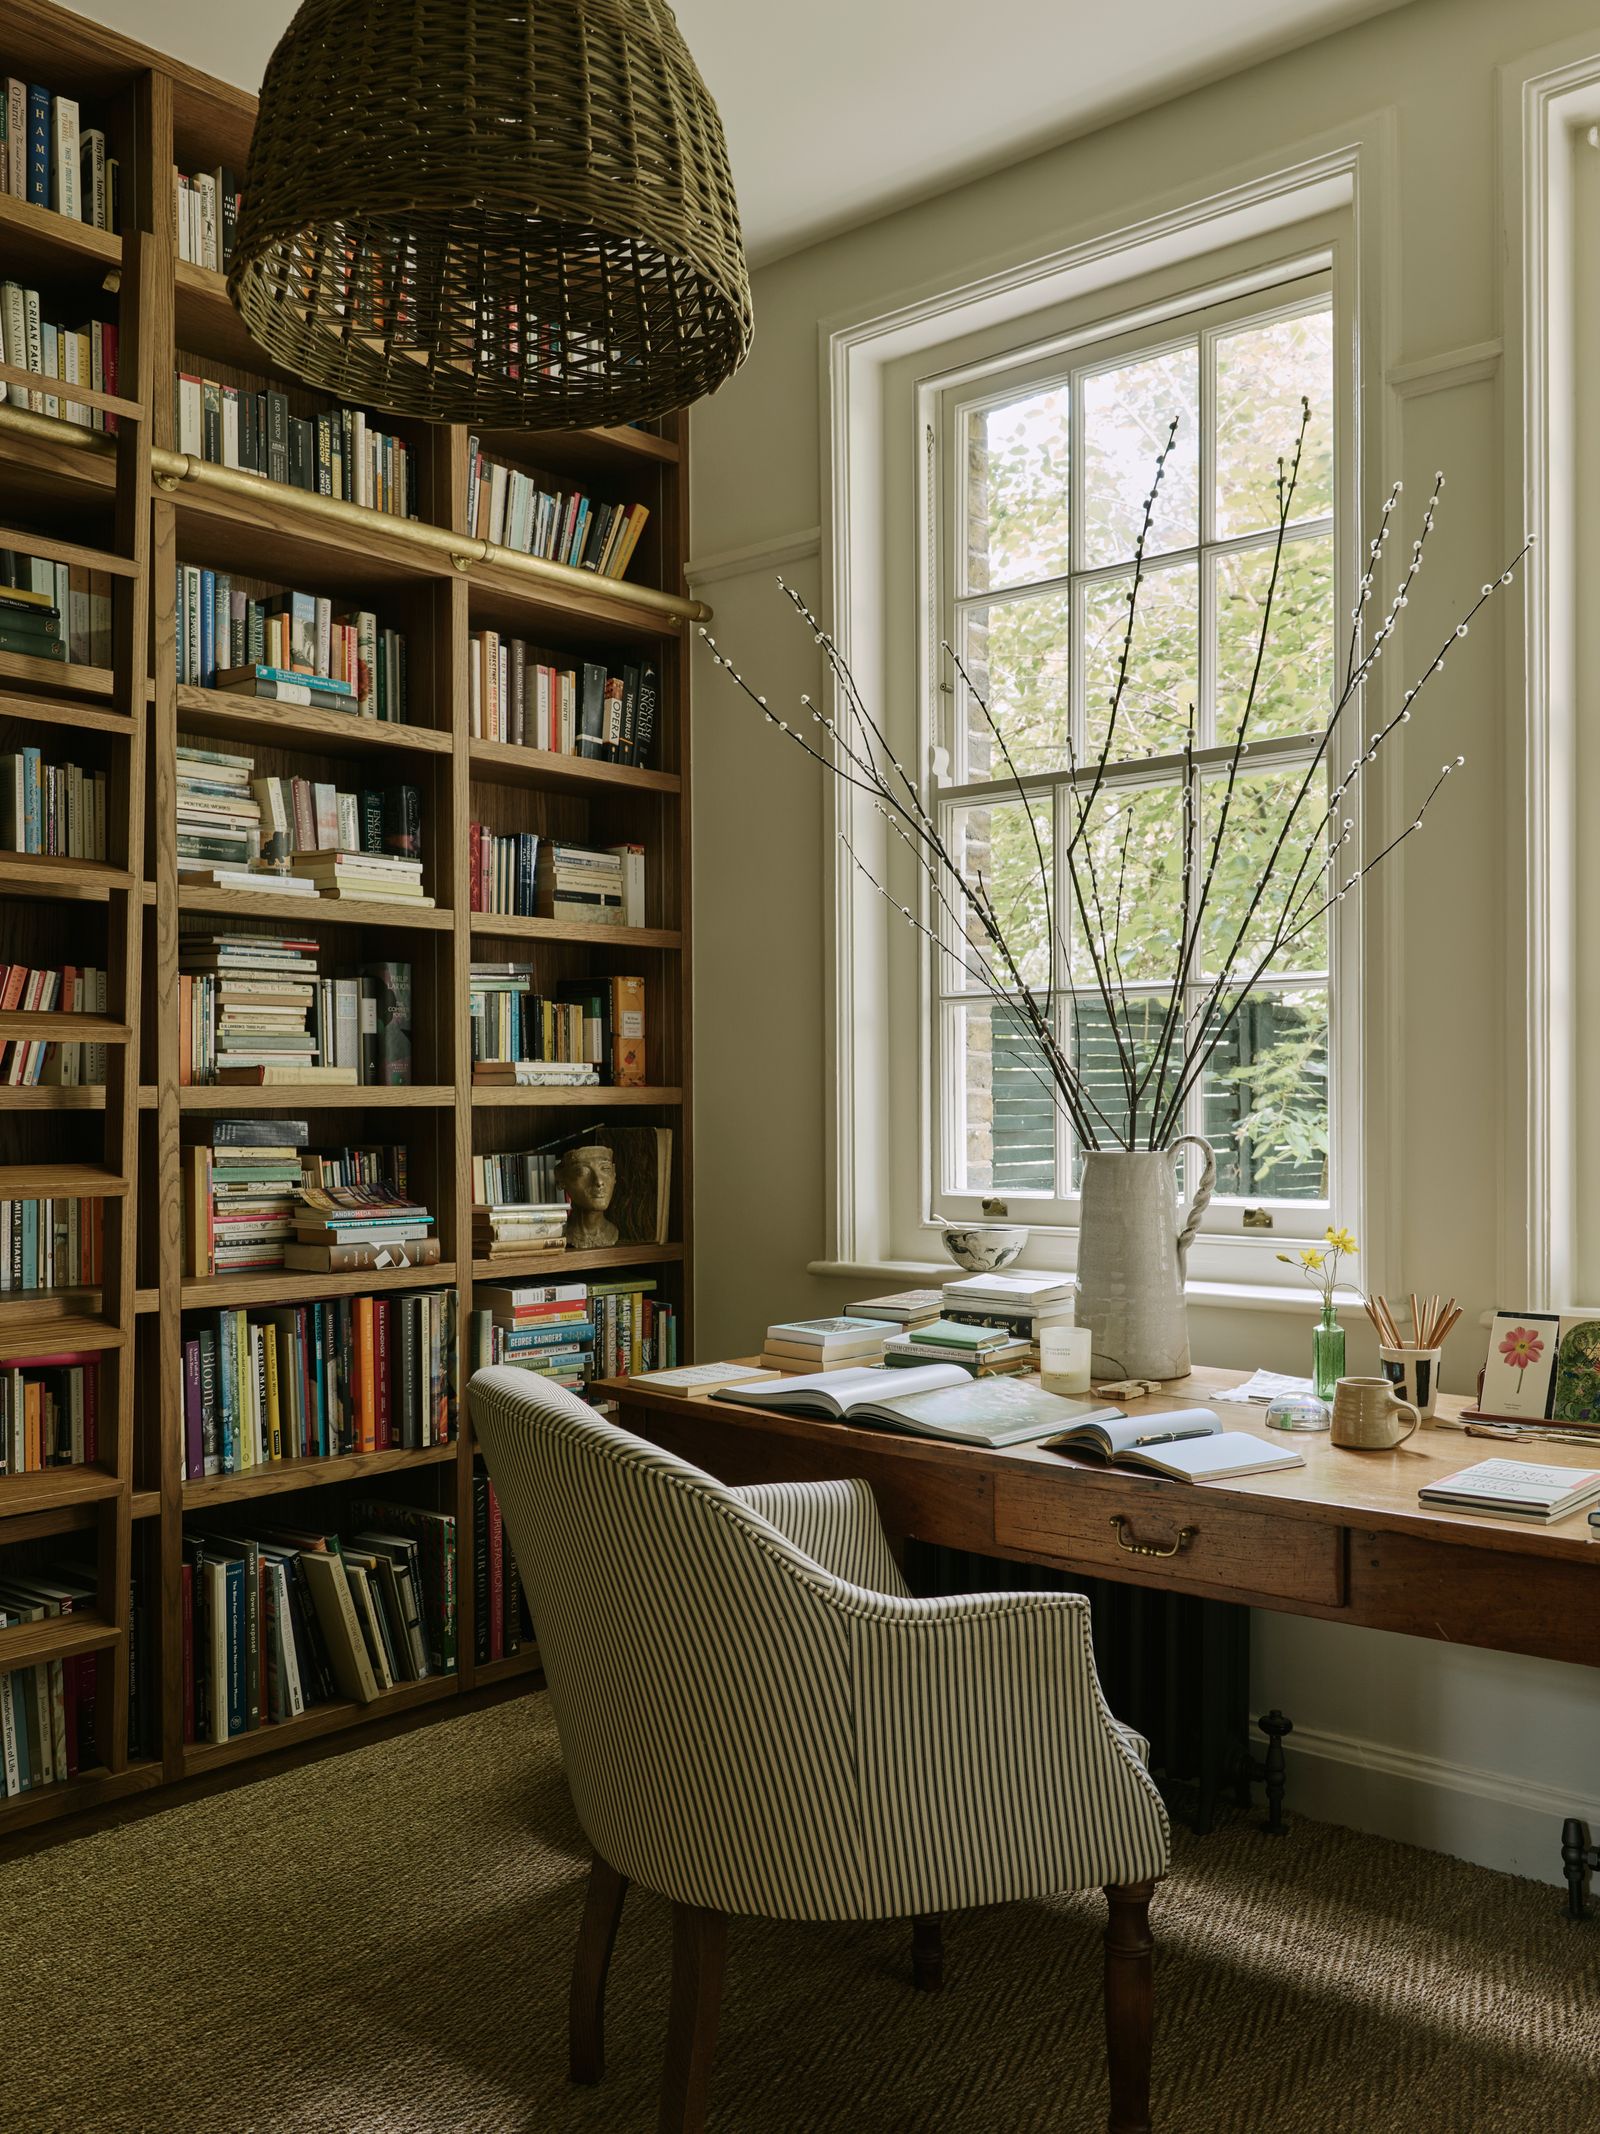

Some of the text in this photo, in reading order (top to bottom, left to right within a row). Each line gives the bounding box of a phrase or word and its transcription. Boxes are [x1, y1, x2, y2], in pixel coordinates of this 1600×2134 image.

[11, 86, 21, 131] O'Farrell
[61, 113, 69, 143] O'FARRELL
[95, 136, 104, 172] Mayflies
[65, 186, 72, 194] BE
[95, 175, 104, 211] Andrew
[224, 196, 234, 204] ALL
[12, 291, 23, 367] ORHAN PAMU
[30, 300, 39, 374] ORHAN PAMU
[274, 399, 282, 439] LEO TOLSTOY
[190, 576, 198, 593] Anne
[190, 593, 198, 609] Tyler
[215, 588, 223, 614] TYLER
[295, 602, 314, 611] JOHN
[190, 617, 198, 638] SPOOL
[254, 614, 263, 657] ANNE TYLER
[190, 638, 198, 647] OF
[190, 646, 198, 662] BLUE
[367, 697, 375, 714] VIJAY
[624, 693, 634, 738] THESAURUS
[638, 687, 650, 736] ENGLISH
[644, 690, 656, 738] CONCISE
[610, 701, 621, 740] OPERA
[183, 800, 231, 811] POETICAL WORKS
[374, 809, 382, 853] ENGLISH
[387, 983, 411, 992] LARKIN
[390, 975, 409, 984] PHILIP
[13, 1199, 22, 1278] MILA SHAMSIE
[510, 1333, 563, 1348] GEORGE SAUNDERS
[608, 1300, 616, 1368] EXIT WOUNDS
[622, 1299, 631, 1370] MAGGIE O'FARRELL
[927, 1347, 946, 1357] Captain
[946, 1349, 954, 1357] and
[201, 1352, 216, 1406] Bloom
[257, 1341, 267, 1397] GREEN MAN
[206, 1434, 216, 1453] Nolan
[1463, 1477, 1522, 1488] PHILIP
[1474, 1464, 1554, 1479] WHITSUN
[1458, 1480, 1521, 1494] LARKIN
[334, 1565, 363, 1654] Lucian Freud Drawings
[280, 1599, 288, 1612] THE
[284, 1632, 294, 1657] STUDIO
[2, 1674, 10, 1689] Piet
[2, 1690, 12, 1727] Mondrian:
[39, 1696, 48, 1722] Jonathan
[6, 1727, 14, 1751] Forms
[8, 1759, 16, 1773] Life
